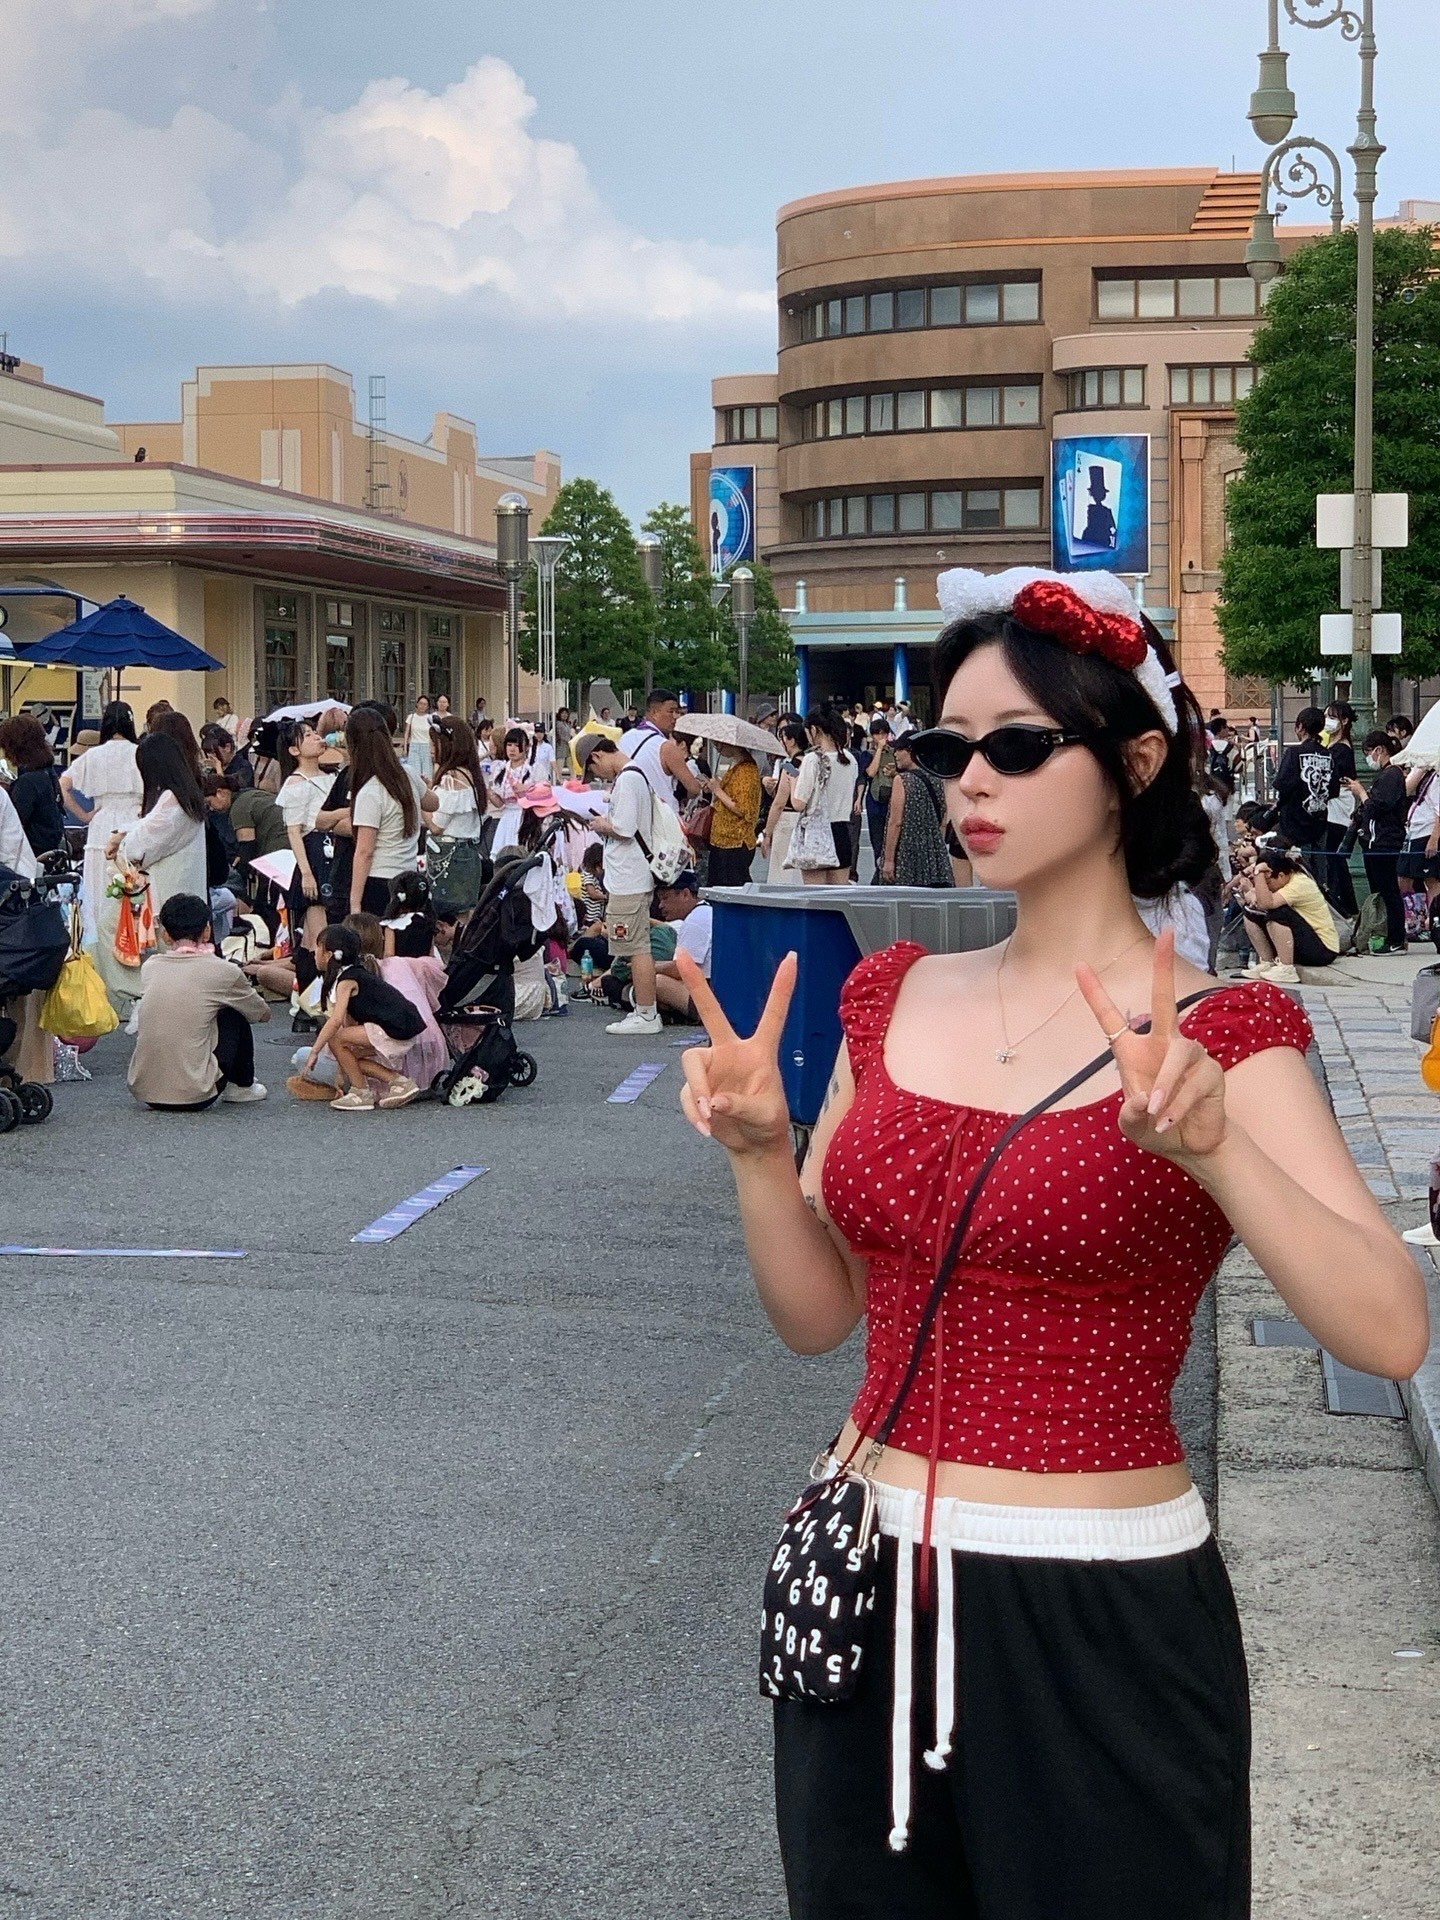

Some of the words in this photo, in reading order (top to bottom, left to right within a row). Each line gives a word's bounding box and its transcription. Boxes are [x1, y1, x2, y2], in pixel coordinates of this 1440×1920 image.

[825, 1511, 842, 1536] 4
[833, 1524, 853, 1550] 5
[772, 1543, 791, 1572] 8
[789, 1578, 802, 1606] 6
[811, 1575, 828, 1606] 8
[774, 1612, 785, 1641] 9
[786, 1625, 797, 1655] 8
[800, 1637, 807, 1662] 1
[809, 1629, 822, 1654] 2
